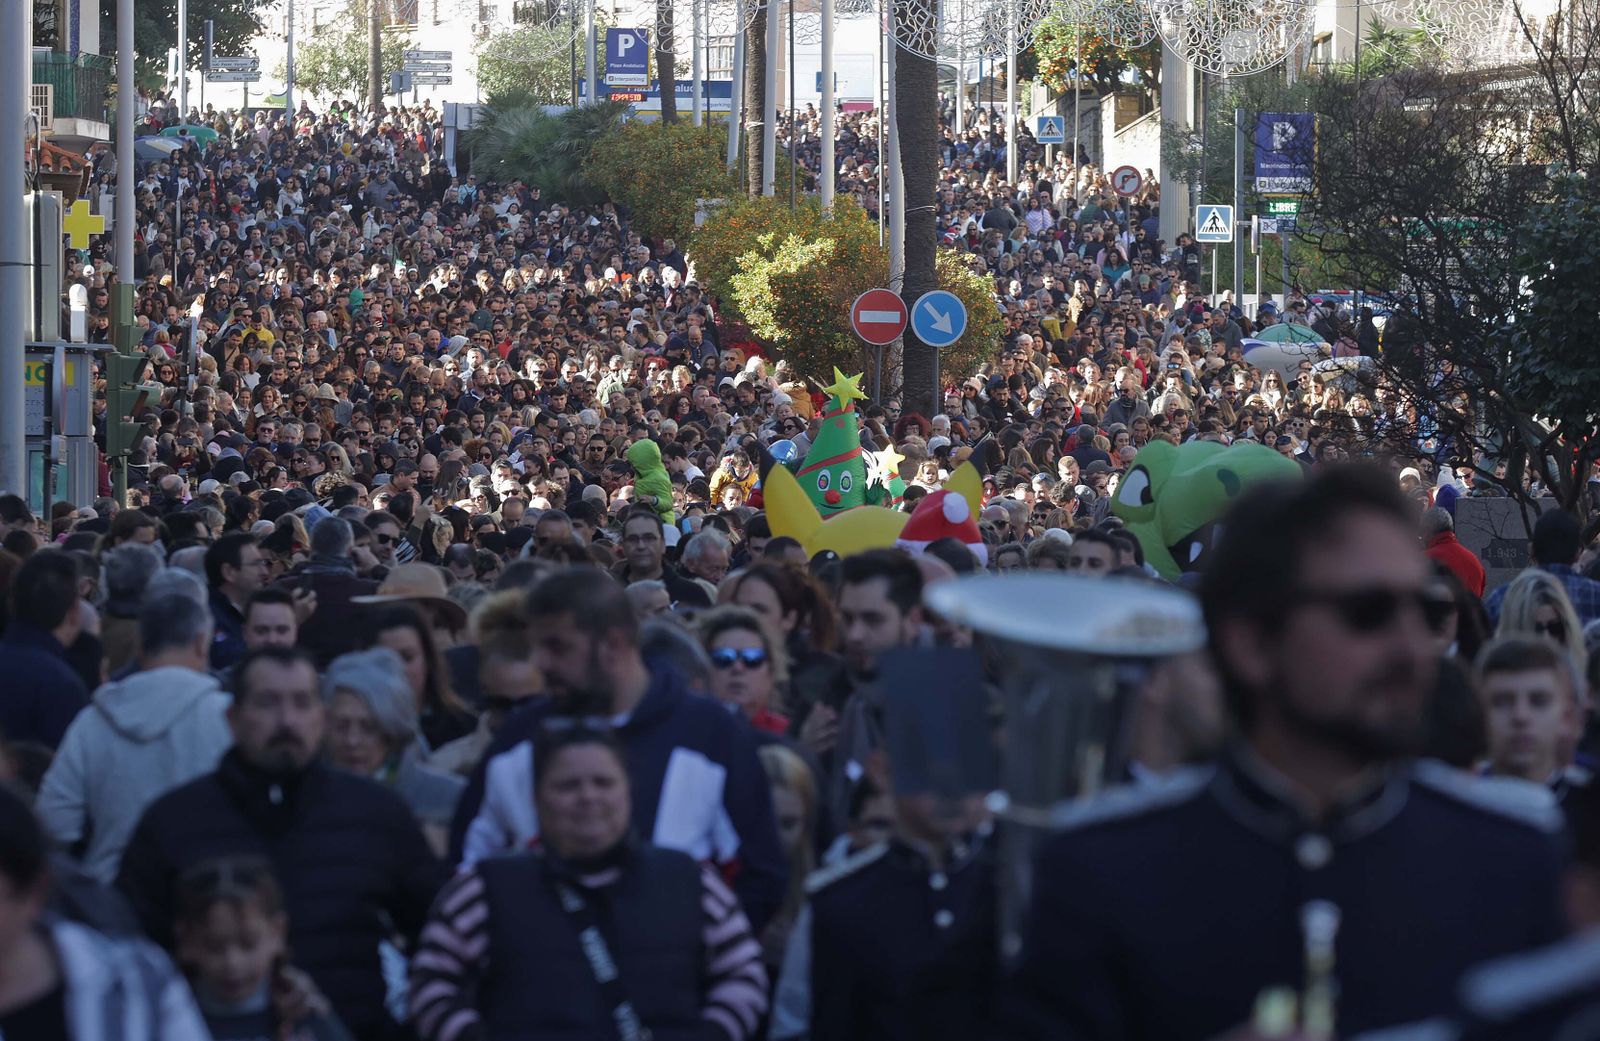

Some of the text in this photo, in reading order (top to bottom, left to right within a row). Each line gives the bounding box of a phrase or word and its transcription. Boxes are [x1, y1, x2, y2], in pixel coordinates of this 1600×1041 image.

[618, 34, 635, 57] P
[1273, 122, 1296, 152] P
[1269, 202, 1297, 212] LIBRE
